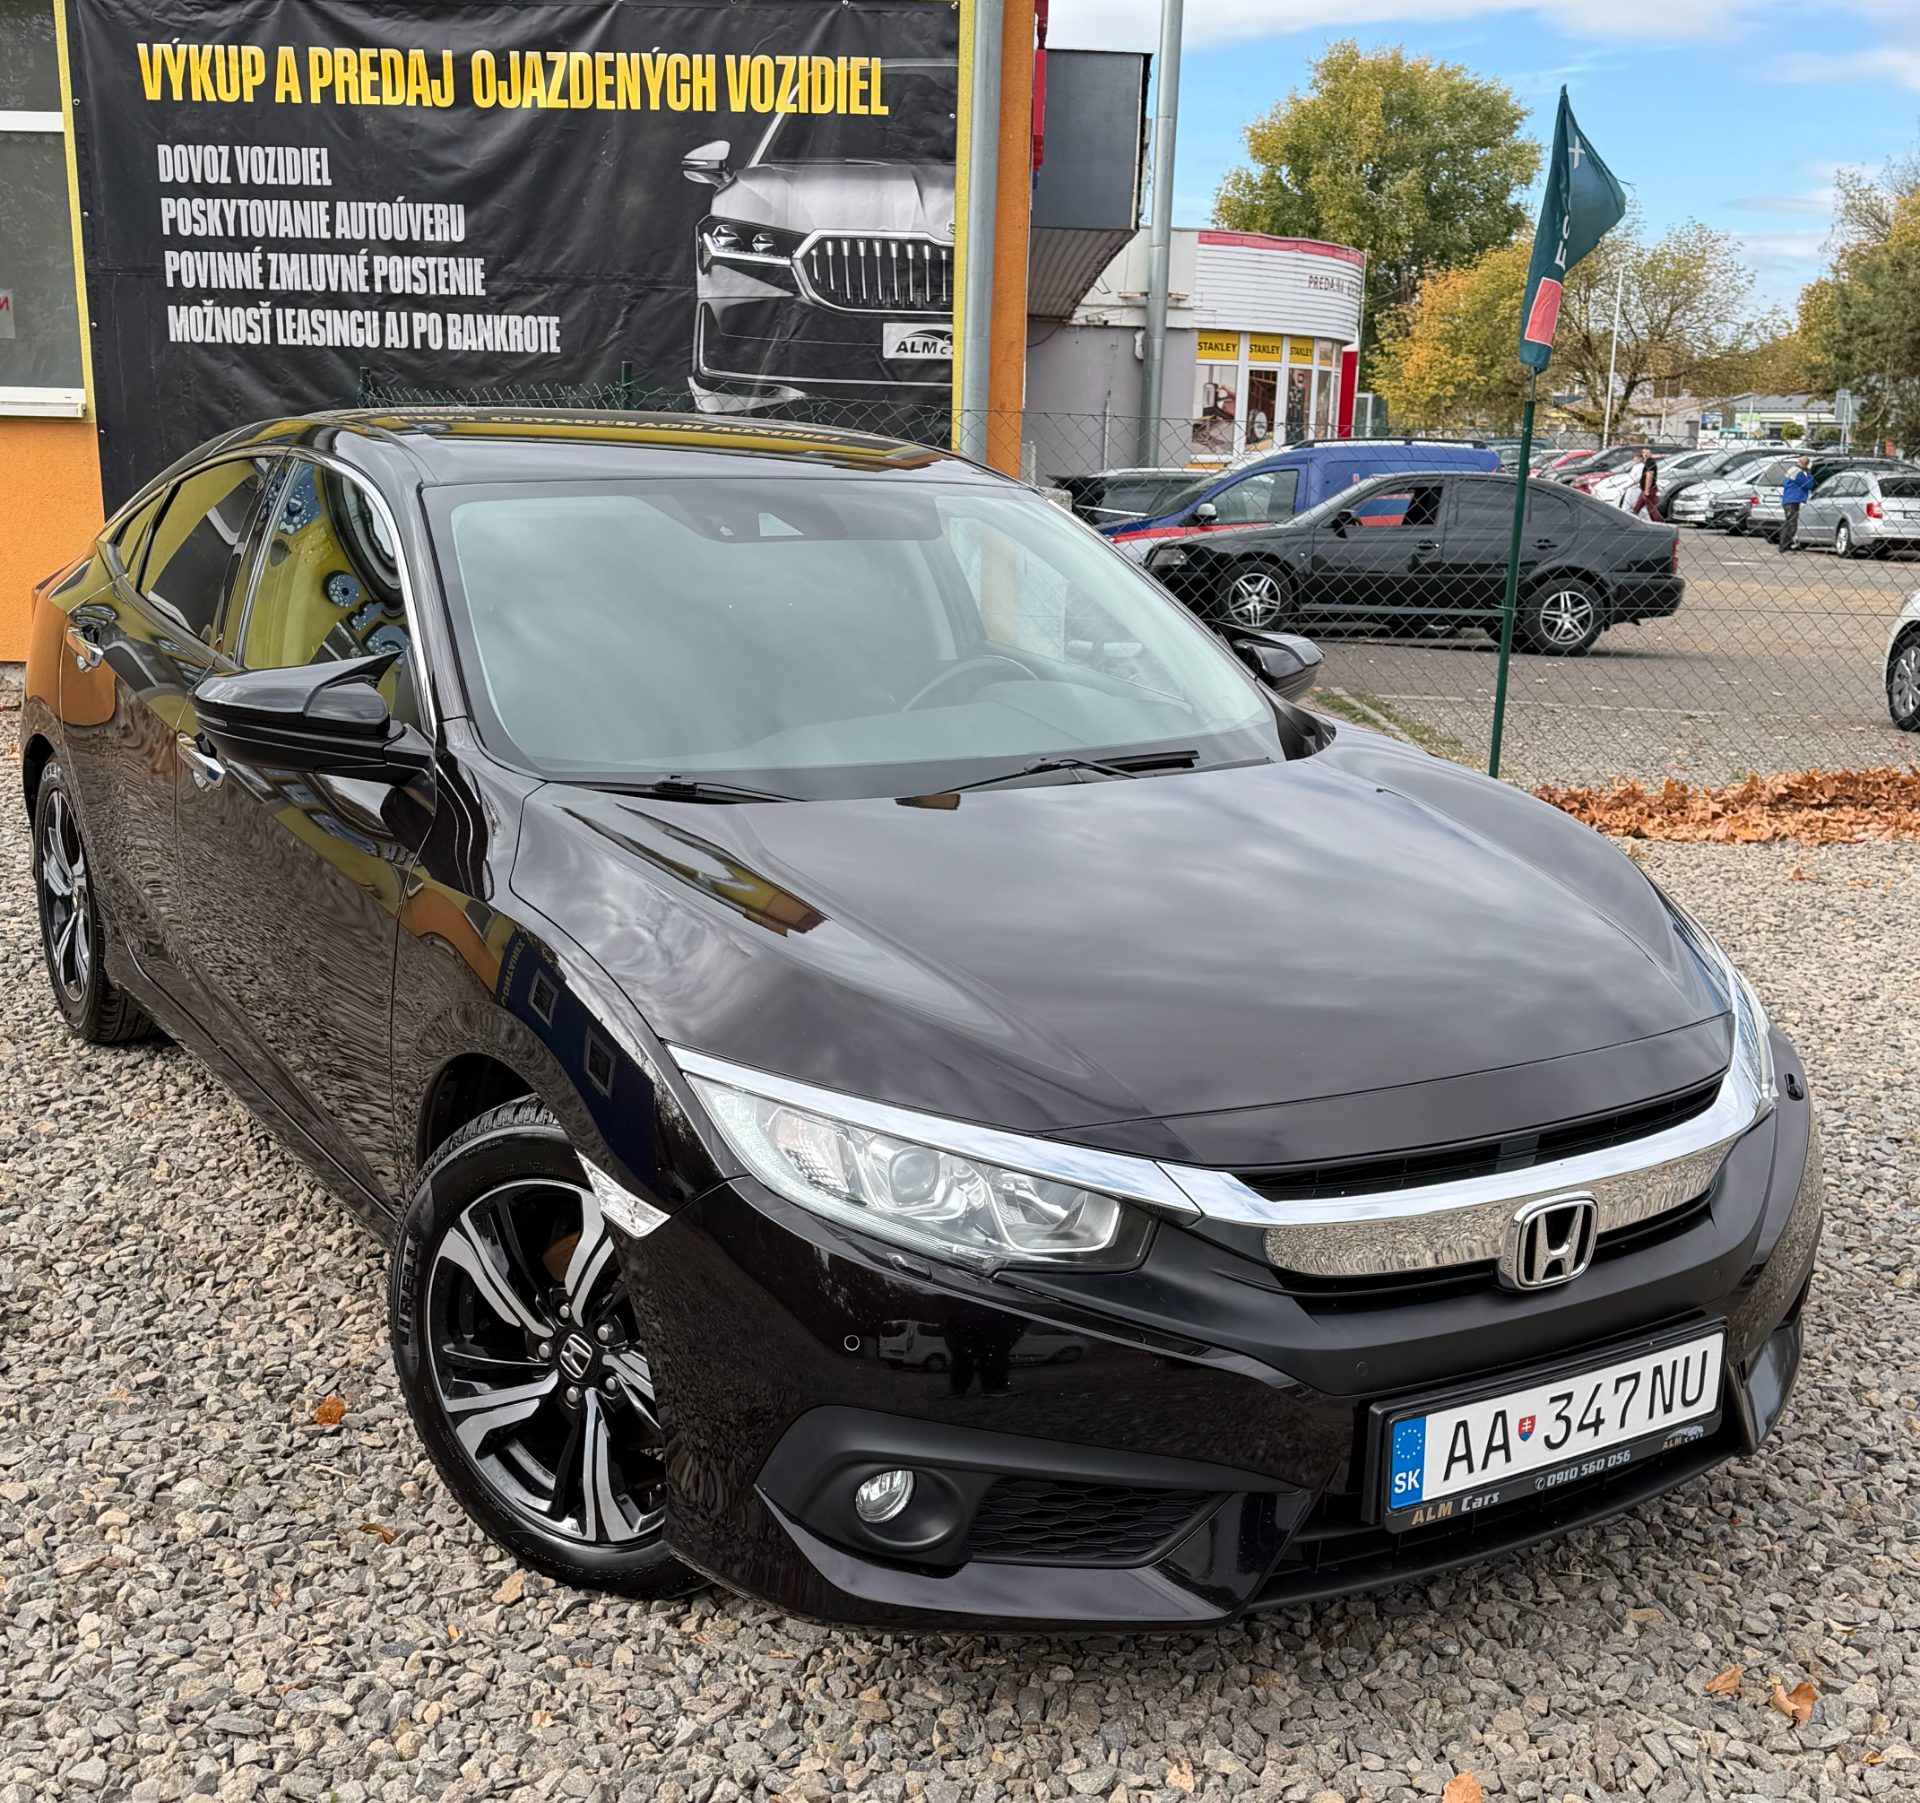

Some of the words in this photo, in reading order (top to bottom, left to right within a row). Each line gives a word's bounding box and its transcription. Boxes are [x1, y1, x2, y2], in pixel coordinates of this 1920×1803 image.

[136, 37, 266, 102] VÝKUP
[274, 46, 302, 104] A
[308, 46, 455, 108] PREDAJ
[471, 46, 716, 112] OJAZDENÝCH
[725, 54, 889, 115] VOZIDIEL
[157, 144, 231, 184] DOVOZ
[234, 146, 332, 186] VOZIDIEL
[161, 197, 330, 239] POSKYTOVANIE
[335, 196, 465, 242] AUTOÚVERU
[164, 246, 264, 290] POVINNÉ
[267, 248, 370, 293] ZMLUVNÉ
[373, 255, 486, 296] POISTENIE
[167, 299, 272, 346] MOŽNOSŤ
[276, 307, 380, 348] LEASINGU
[384, 310, 409, 350] AJ
[412, 311, 442, 350] PO
[446, 313, 561, 354] BANKROTE
[895, 340, 938, 354] ALM
[1197, 341, 1238, 353] STANLEY
[1249, 343, 1280, 355] STANLEY
[1289, 346, 1313, 357] STANLEY
[1442, 1409, 1512, 1482] AA
[1543, 1350, 1709, 1451] 347NU
[1394, 1468, 1421, 1494] SK
[1411, 1501, 1453, 1526] ALM
[1461, 1492, 1500, 1513] Cars
[1546, 1466, 1579, 1487] 0910
[1580, 1458, 1605, 1477] 560
[1607, 1450, 1631, 1468] 056
